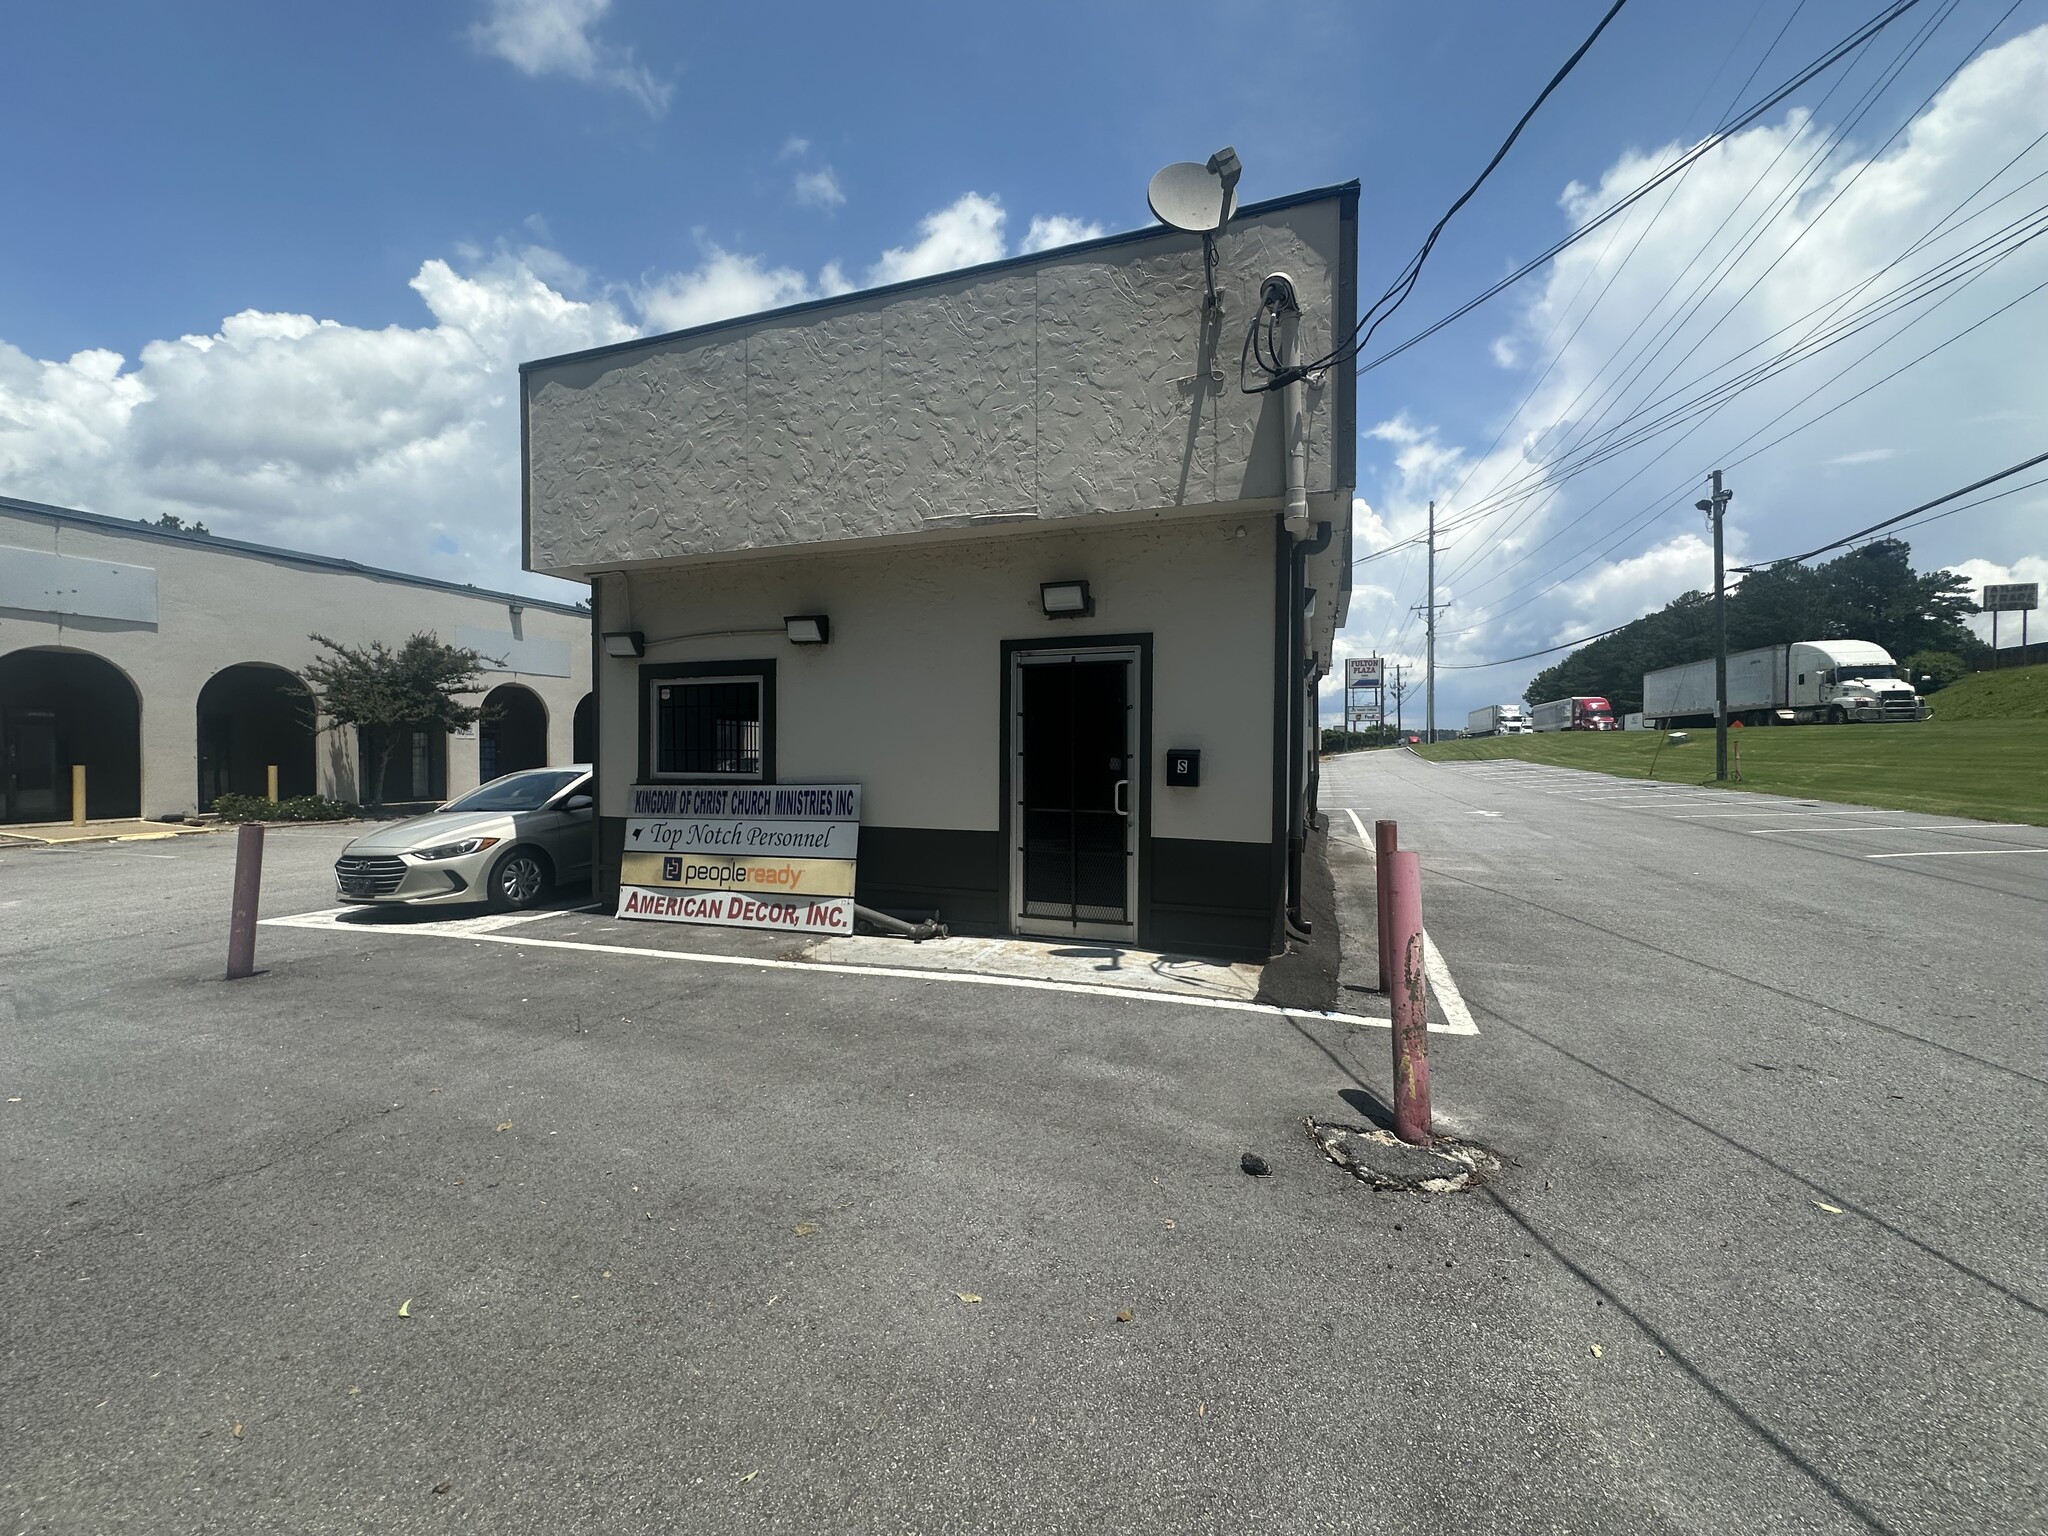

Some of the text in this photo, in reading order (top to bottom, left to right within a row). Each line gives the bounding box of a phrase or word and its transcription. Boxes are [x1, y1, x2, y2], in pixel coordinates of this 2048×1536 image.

[1179, 761, 1186, 772] S
[634, 789, 854, 817] KINGDOM OF CHRIST CHURCH MINISTRIES INC
[650, 822, 836, 849] Top Notch Personnel
[625, 891, 848, 928] AMERICAN DECOR, INC.
